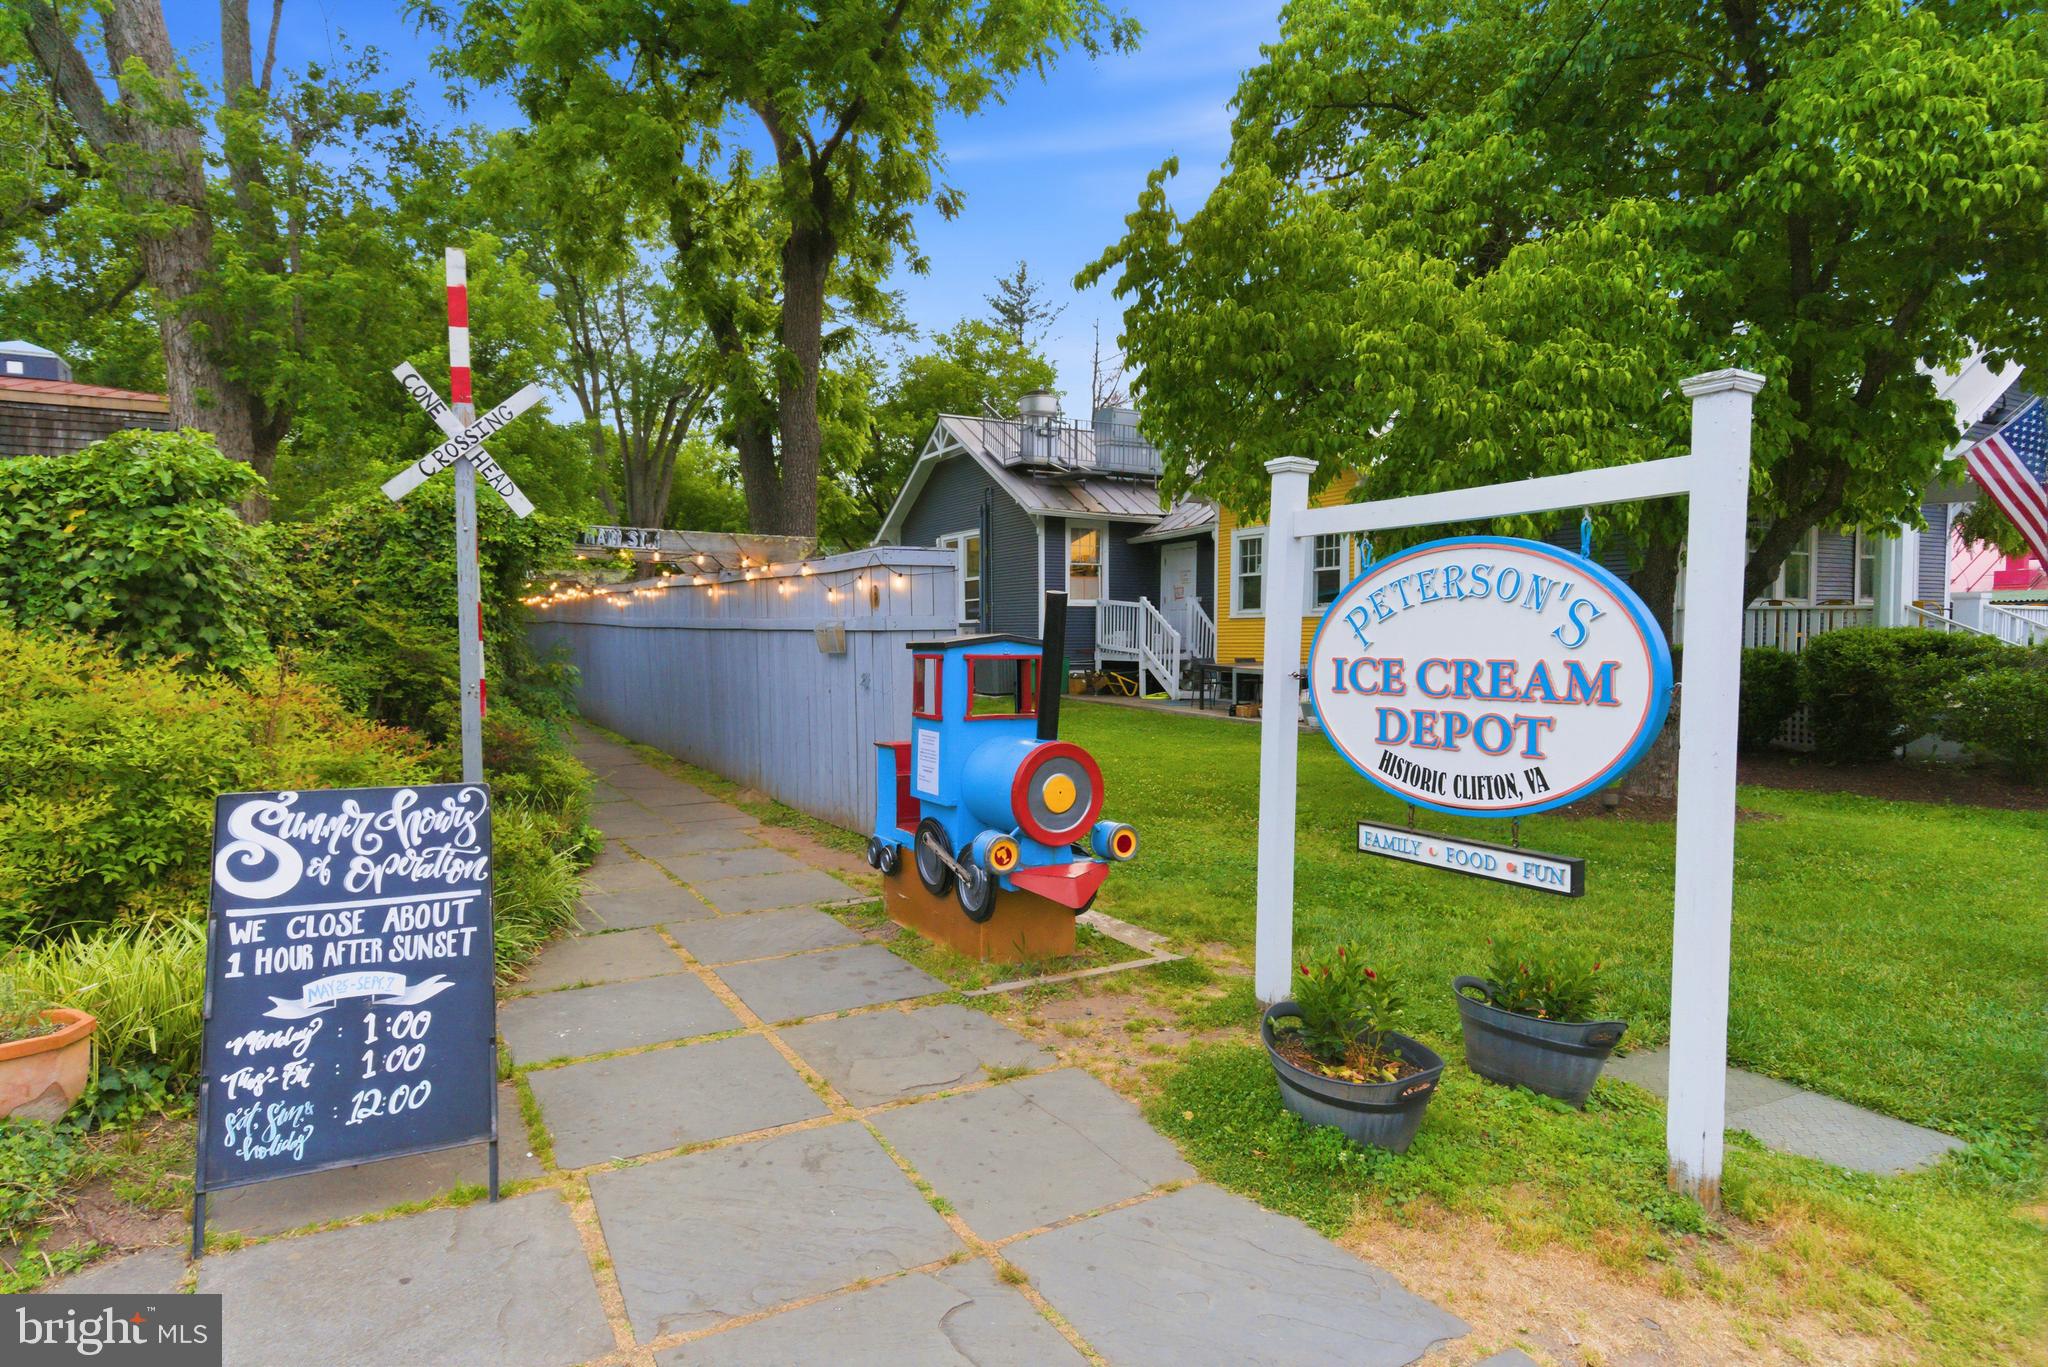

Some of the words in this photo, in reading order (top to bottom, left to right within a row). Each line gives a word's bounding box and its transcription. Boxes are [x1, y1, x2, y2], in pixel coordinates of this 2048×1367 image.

[402, 373, 447, 420] CONE
[469, 450, 515, 498] HEAD
[418, 405, 514, 477] CROSSING
[1344, 563, 1605, 650] PETERSON'S
[1332, 657, 1407, 696] ICE
[1416, 658, 1622, 707] CREAM
[1374, 706, 1556, 760] DEPOT
[1378, 749, 1447, 797] HISTORIC
[1453, 772, 1524, 801] CLIFTON,
[1524, 766, 1551, 795] VA
[306, 854, 331, 886] of
[1364, 831, 1422, 857] FAMILY
[1446, 846, 1497, 871] FOOD
[1523, 861, 1566, 886] FUN
[228, 918, 267, 945] WE
[286, 909, 366, 940] CLOSE
[381, 898, 475, 934] ABOUT
[224, 952, 245, 978] 1
[255, 944, 314, 976] HOUR
[322, 938, 383, 968] AFTER
[388, 927, 478, 964] SUNSET
[225, 1017, 323, 1058] Monday
[363, 1010, 432, 1044] 1:00
[362, 1043, 426, 1079] 1:00
[345, 1079, 432, 1126] 12:00
